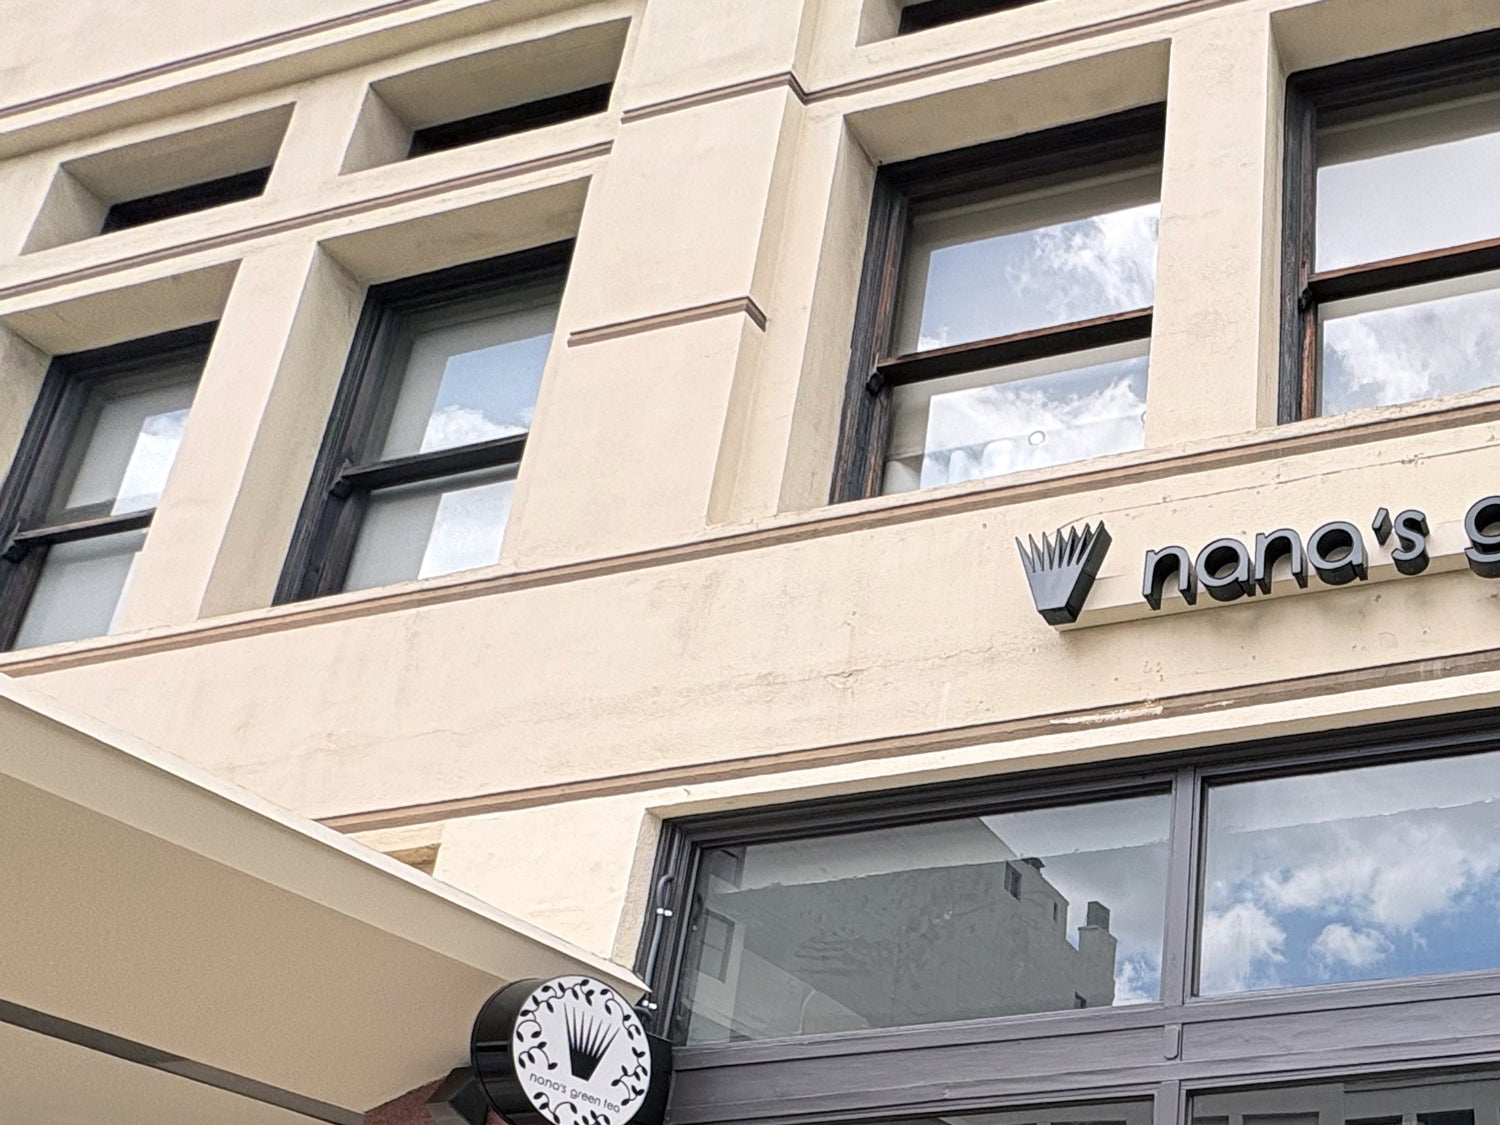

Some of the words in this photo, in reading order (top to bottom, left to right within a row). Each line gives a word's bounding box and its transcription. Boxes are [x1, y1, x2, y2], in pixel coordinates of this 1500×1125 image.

[1141, 505, 1430, 612] nana's
[529, 1072, 567, 1094] nana's
[570, 1088, 602, 1106] green
[604, 1099, 621, 1113] tea
